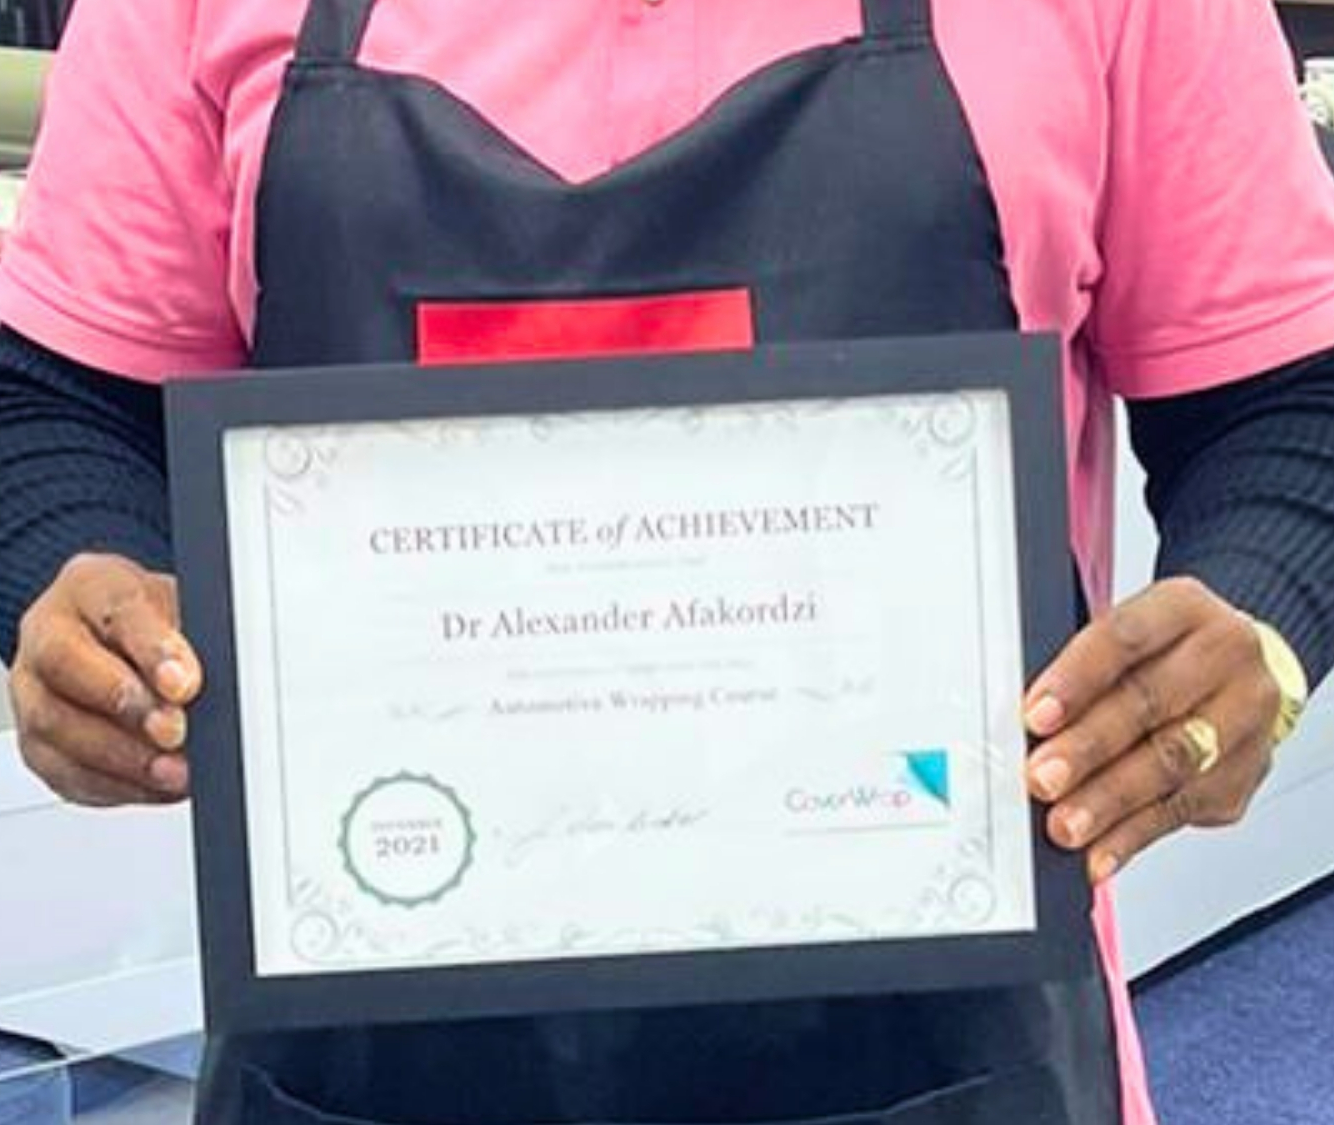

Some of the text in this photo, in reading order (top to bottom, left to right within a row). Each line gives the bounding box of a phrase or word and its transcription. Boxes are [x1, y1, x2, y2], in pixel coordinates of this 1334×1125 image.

[369, 503, 881, 556] CERTIFICATE of ACHIEVEMENT
[440, 591, 820, 642] Dr Alexander Afakordzi
[373, 834, 441, 860] 2021
